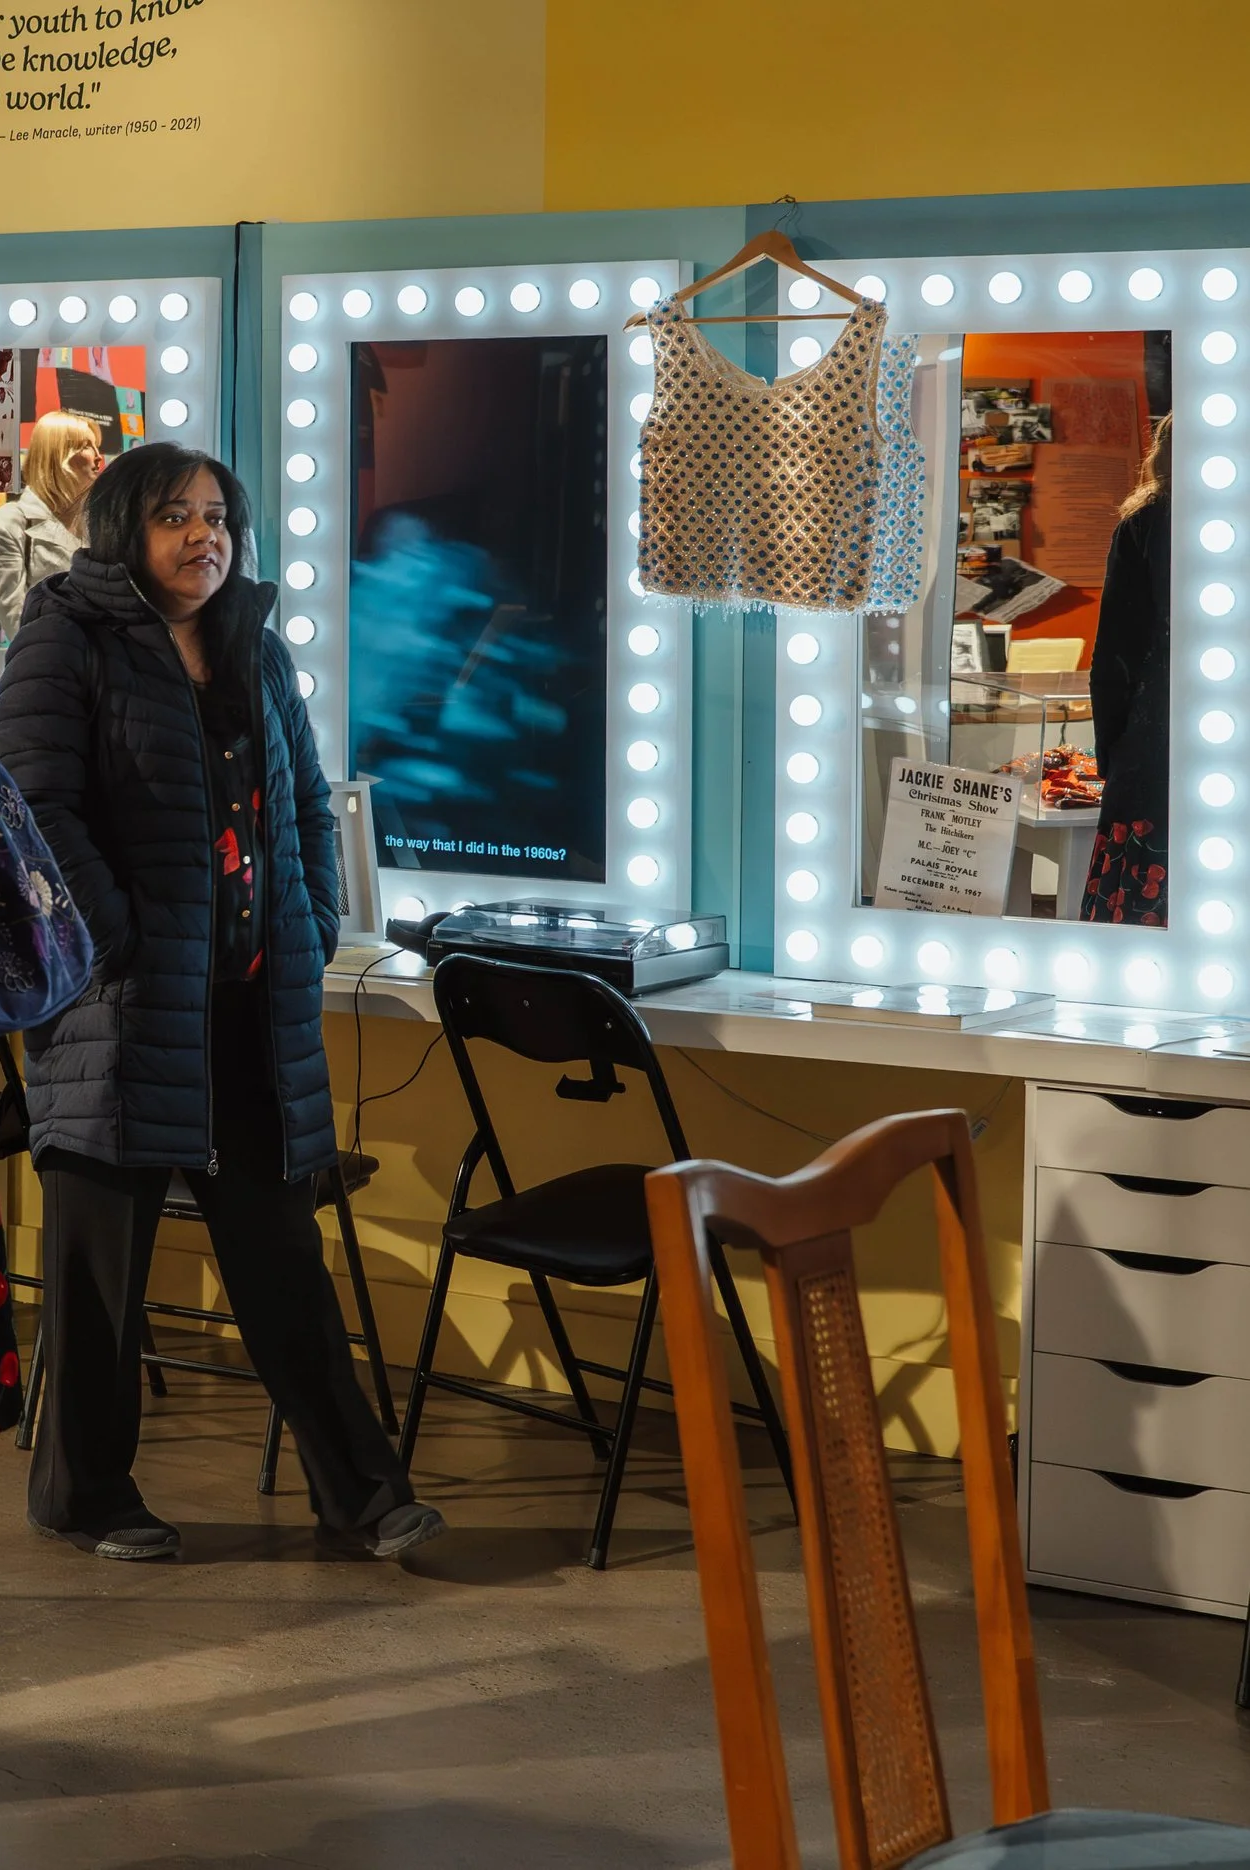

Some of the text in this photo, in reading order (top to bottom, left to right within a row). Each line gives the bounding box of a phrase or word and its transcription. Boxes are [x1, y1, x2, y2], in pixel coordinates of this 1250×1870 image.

[7, 5, 88, 39] youth
[95, 5, 122, 30] to
[22, 35, 178, 72] knowledge,
[5, 81, 101, 110] world."
[10, 129, 29, 141] Lee
[32, 125, 81, 140] Maracle,
[85, 123, 123, 137] writer
[125, 119, 157, 136] (1950
[170, 116, 201, 131] 2021)
[899, 768, 1013, 802] JACKIE SHANE'S
[908, 788, 999, 815] Christmas Show
[920, 808, 982, 828] FRANK MOTLEY
[925, 823, 975, 840] The Hitchikers
[385, 835, 566, 861] the way that I did in the 1960s?
[910, 857, 940, 870] PALAIS
[945, 865, 978, 877] ROYALE
[901, 874, 945, 890] DECEMBER
[949, 885, 960, 895] 21,
[964, 888, 982, 898] 1967
